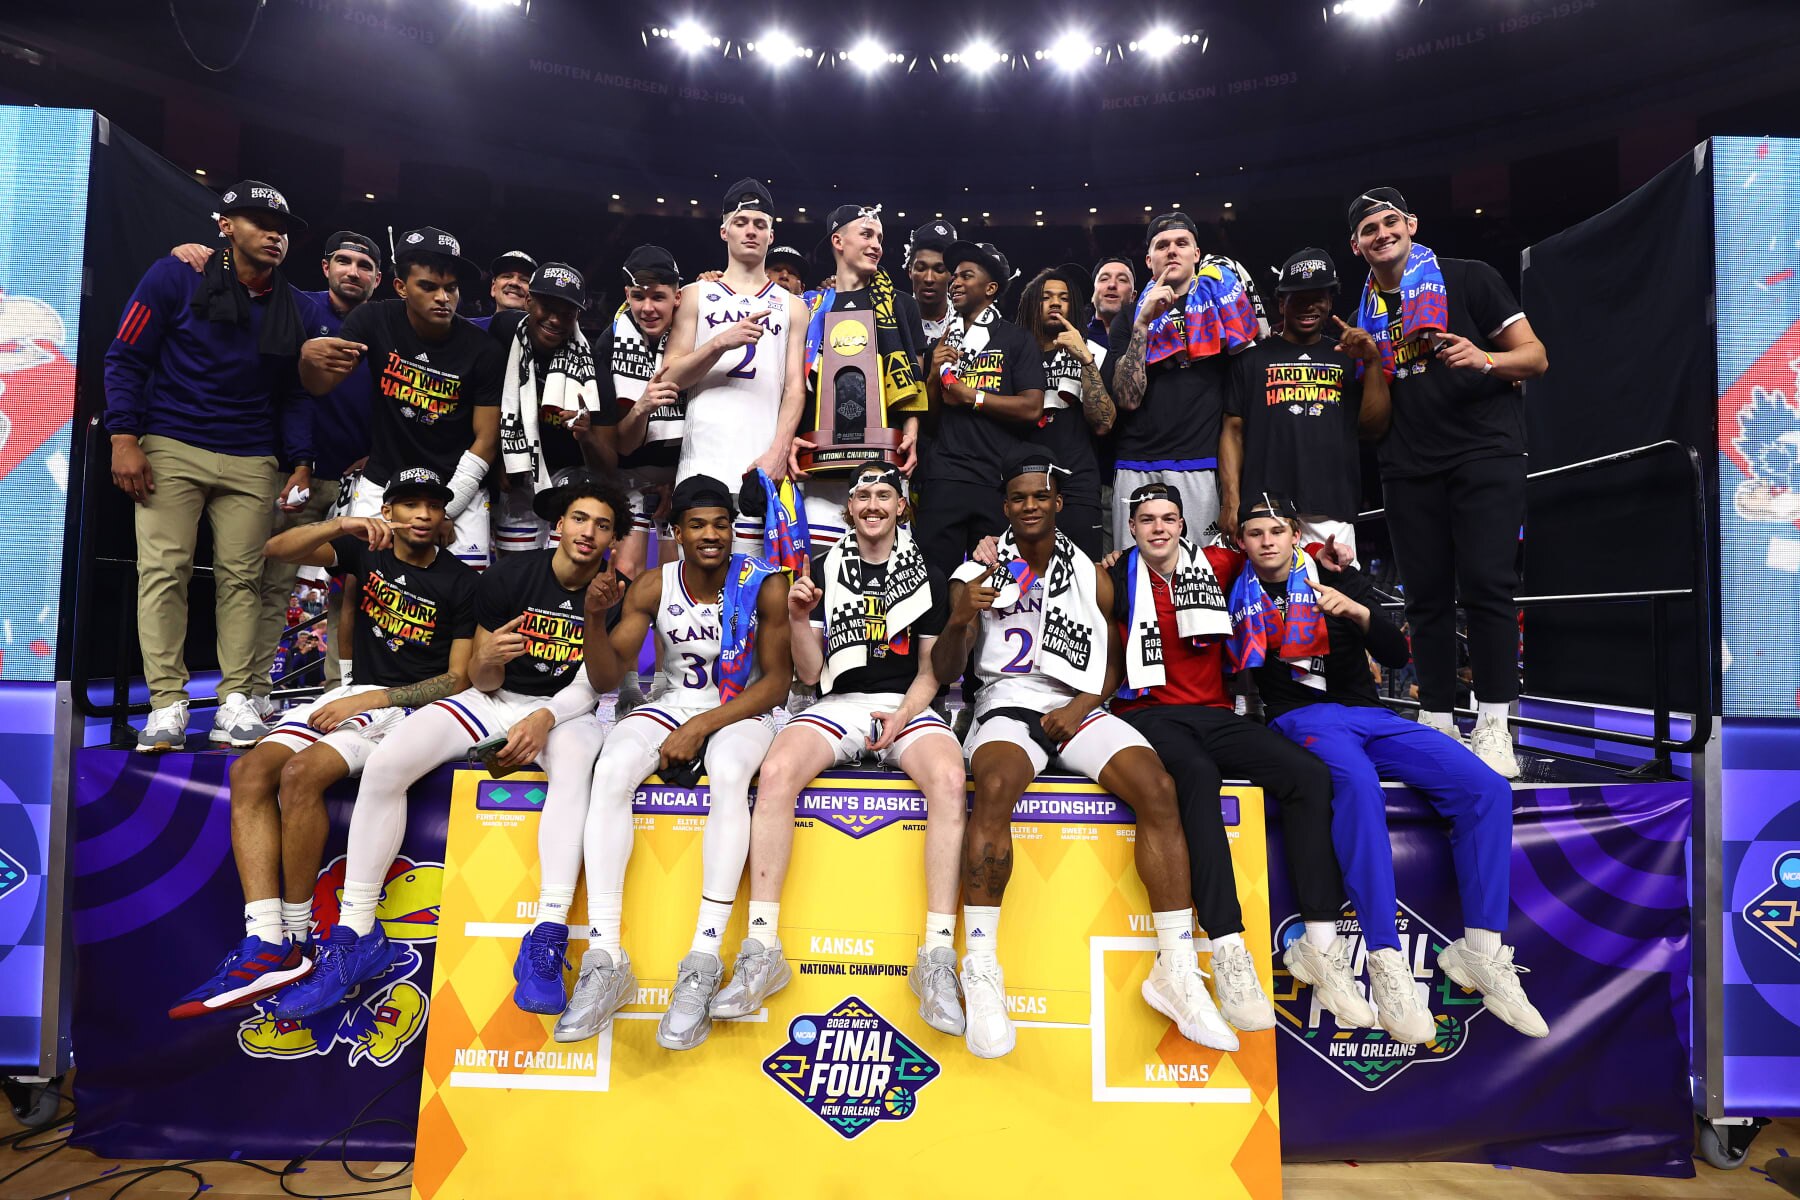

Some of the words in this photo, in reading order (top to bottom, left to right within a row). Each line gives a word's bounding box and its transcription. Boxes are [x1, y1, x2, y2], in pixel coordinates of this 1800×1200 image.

[1396, 42, 1433, 61] SAM
[1435, 27, 1485, 50] MILLS
[529, 59, 590, 81] MORTEN
[593, 71, 668, 95] ANDERSEN
[1102, 95, 1149, 110] RICKEY
[1151, 86, 1216, 104] JACKSON
[1227, 71, 1297, 94] 1981-1993
[705, 310, 782, 336] KANAS
[726, 342, 757, 379] 2
[1266, 367, 1301, 384] HARD
[1305, 367, 1343, 384] WORK
[380, 376, 458, 414] HARDWARE
[1266, 387, 1341, 406] HARDWARE
[818, 452, 846, 461] NATIONAL
[846, 451, 880, 460] CHAMPION
[399, 598, 437, 627] WORK
[1000, 627, 1034, 673] 2
[651, 791, 698, 807] NCAA
[804, 795, 858, 809] MEN'S
[863, 796, 927, 811] BASKET
[476, 813, 499, 821] FIRST
[499, 814, 526, 822] ROUND
[1061, 827, 1087, 835] SWEET
[810, 935, 875, 957] KANSAS
[800, 962, 847, 975] NATIONAL
[850, 963, 908, 976] CHAMPIONS
[827, 1018, 850, 1029] 2022
[851, 1018, 879, 1029] MEN'S
[795, 1031, 817, 1040] NCAA
[815, 1029, 895, 1062] FINAL
[1329, 1042, 1358, 1057] NEW
[1362, 1042, 1417, 1057] ORLEANS
[455, 1048, 511, 1068] NORTH
[514, 1050, 594, 1071] CAROLINA
[809, 1063, 892, 1098] FOUR
[1145, 1063, 1209, 1082] KANSAS
[820, 1105, 841, 1116] NEW
[842, 1105, 880, 1116] ORLEANS
